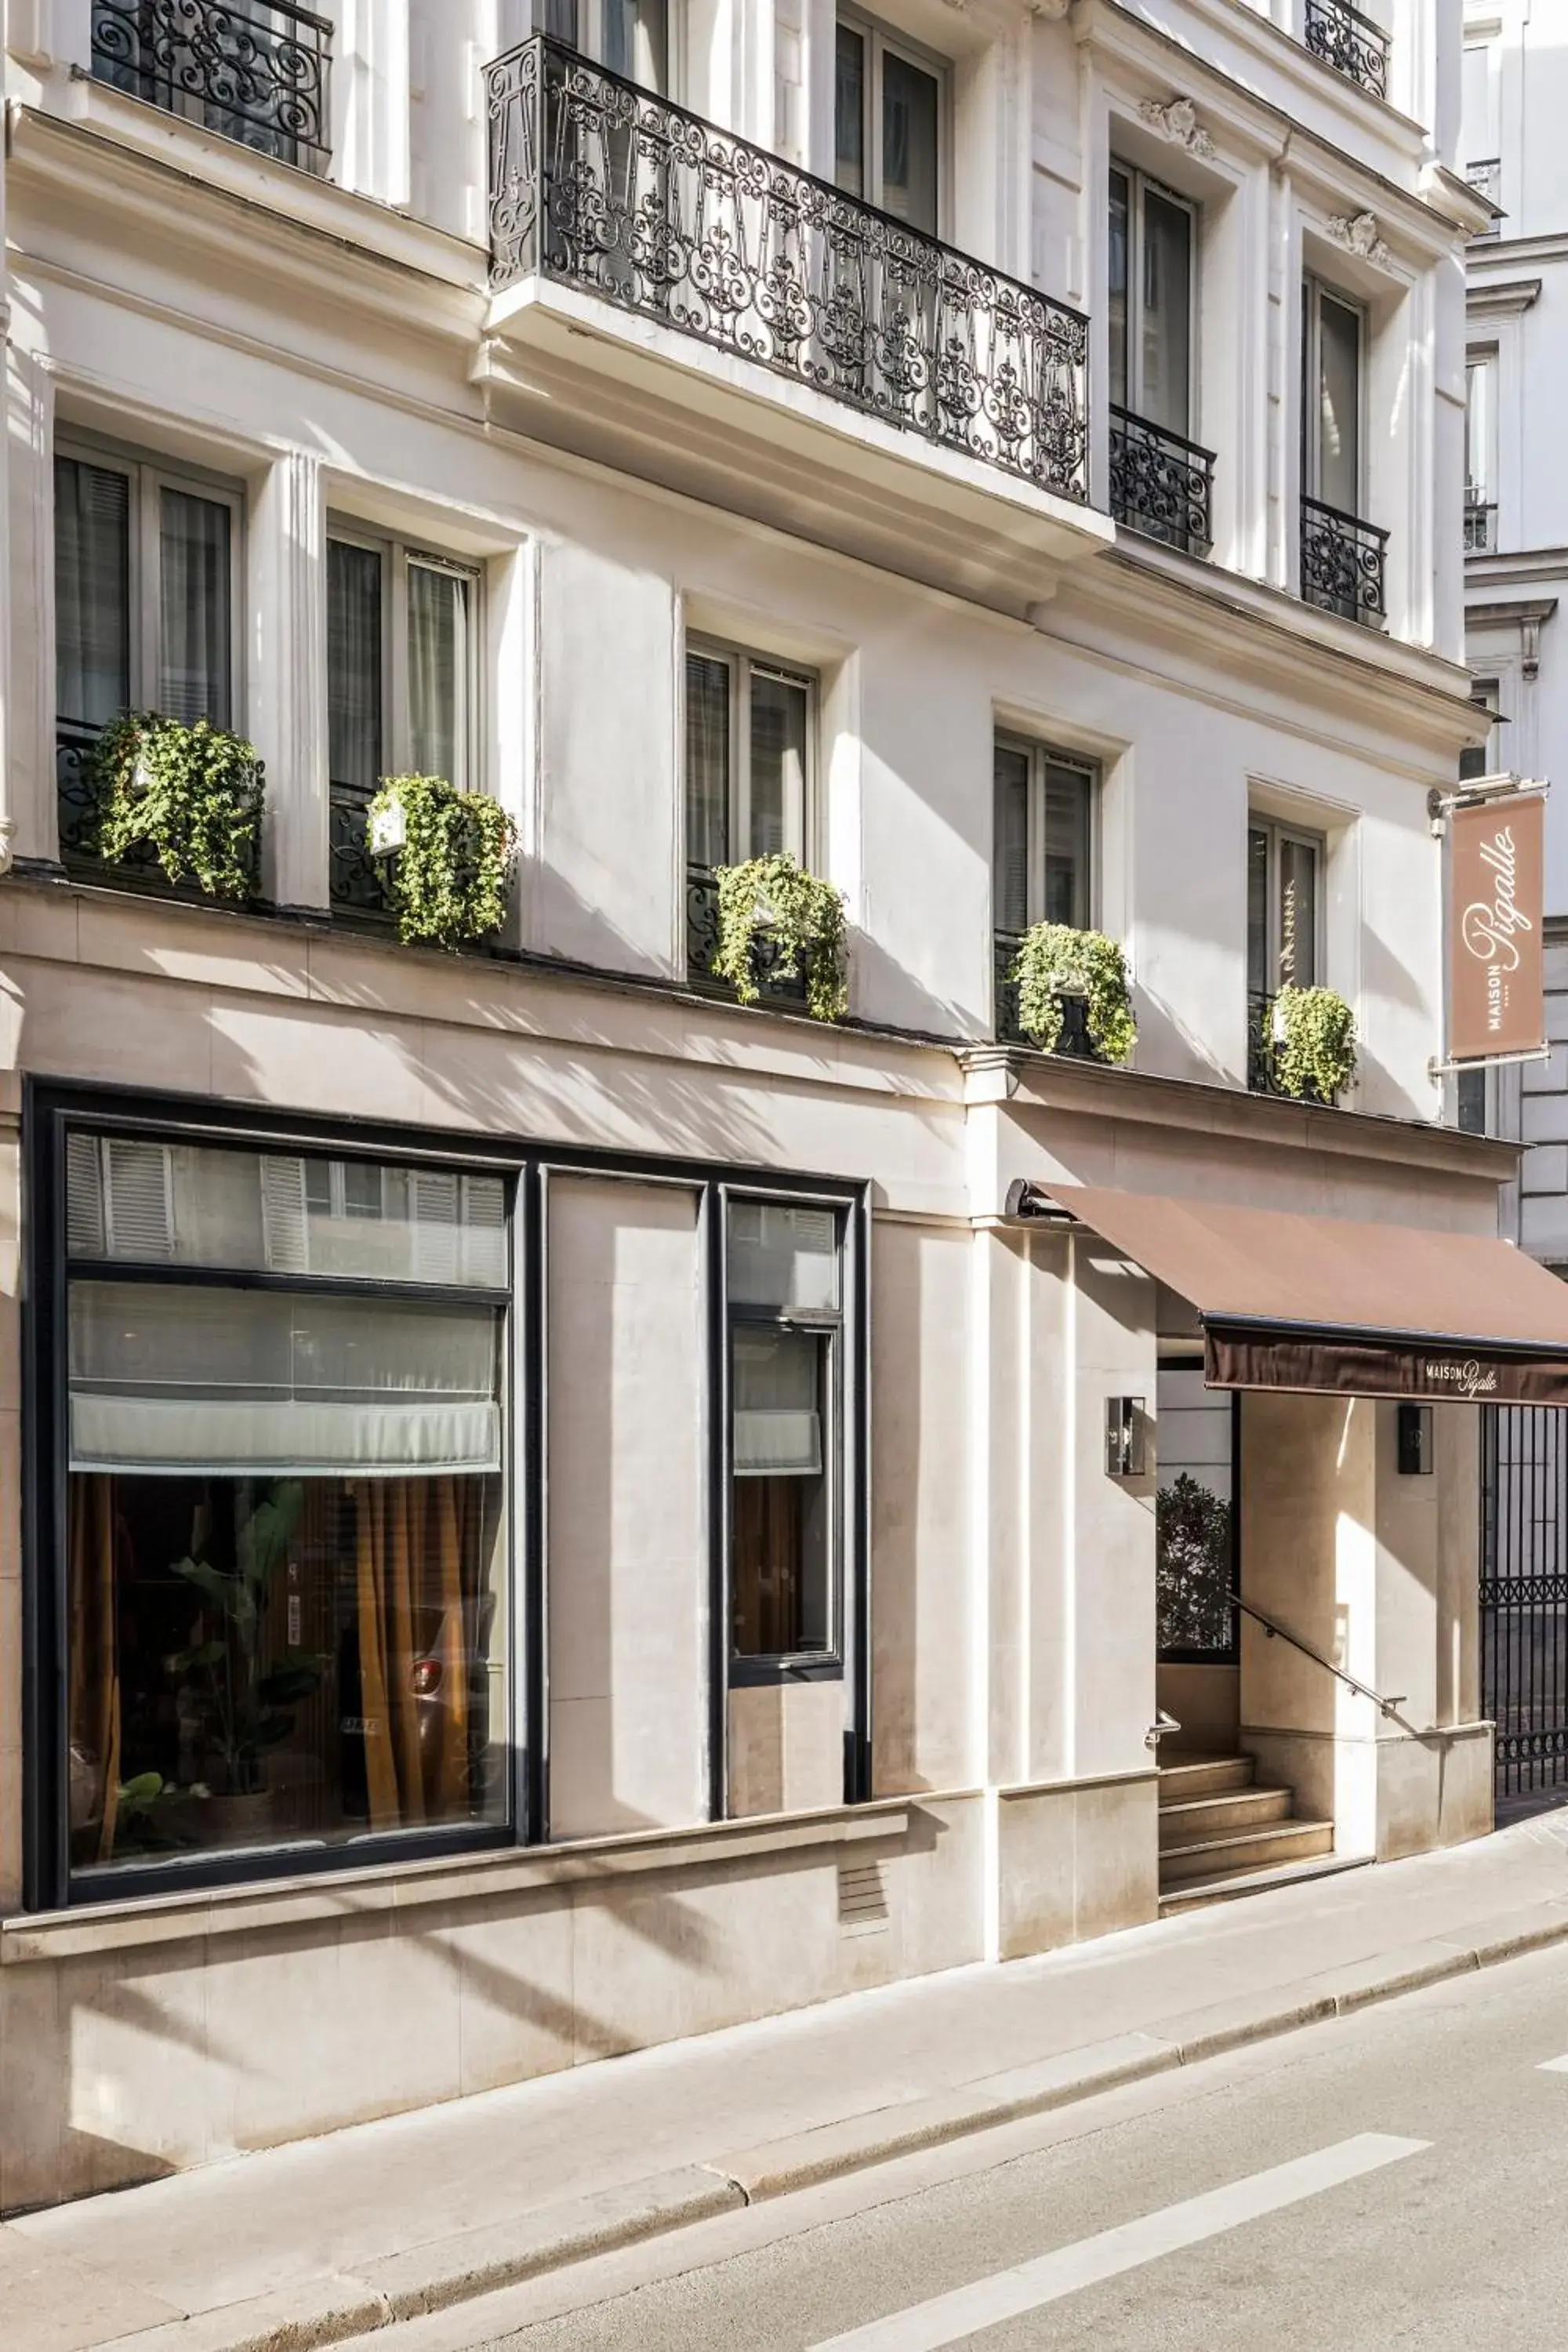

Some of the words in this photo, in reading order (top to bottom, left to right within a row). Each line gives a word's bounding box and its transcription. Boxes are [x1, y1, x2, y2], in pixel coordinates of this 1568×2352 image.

[1462, 826, 1533, 972] Pigalle
[1488, 965, 1501, 1031] MAISON
[1426, 1365, 1462, 1380] MAISON
[1458, 1359, 1497, 1399] Pigalle
